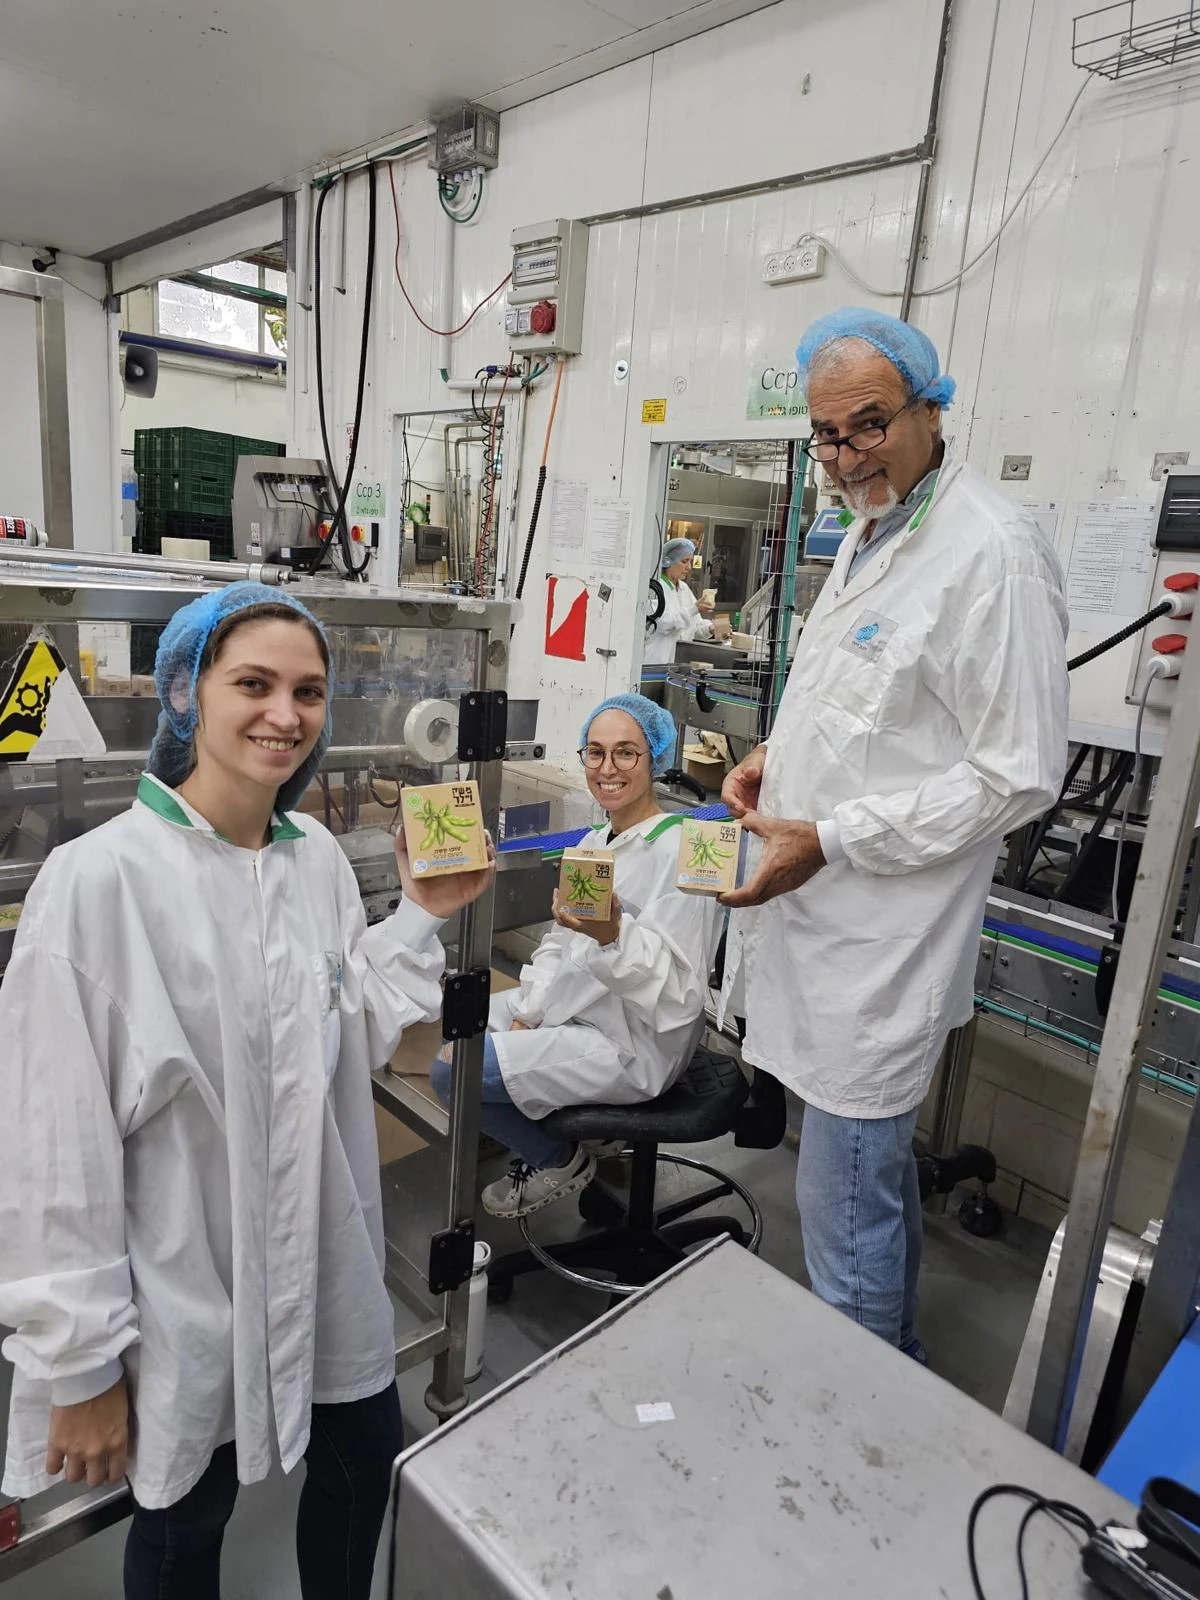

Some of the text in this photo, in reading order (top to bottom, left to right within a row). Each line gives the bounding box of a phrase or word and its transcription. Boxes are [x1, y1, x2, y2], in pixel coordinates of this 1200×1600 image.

[761, 367, 798, 395] Ccp
[356, 482, 381, 500] Ccp 3
[452, 786, 472, 795] משק
